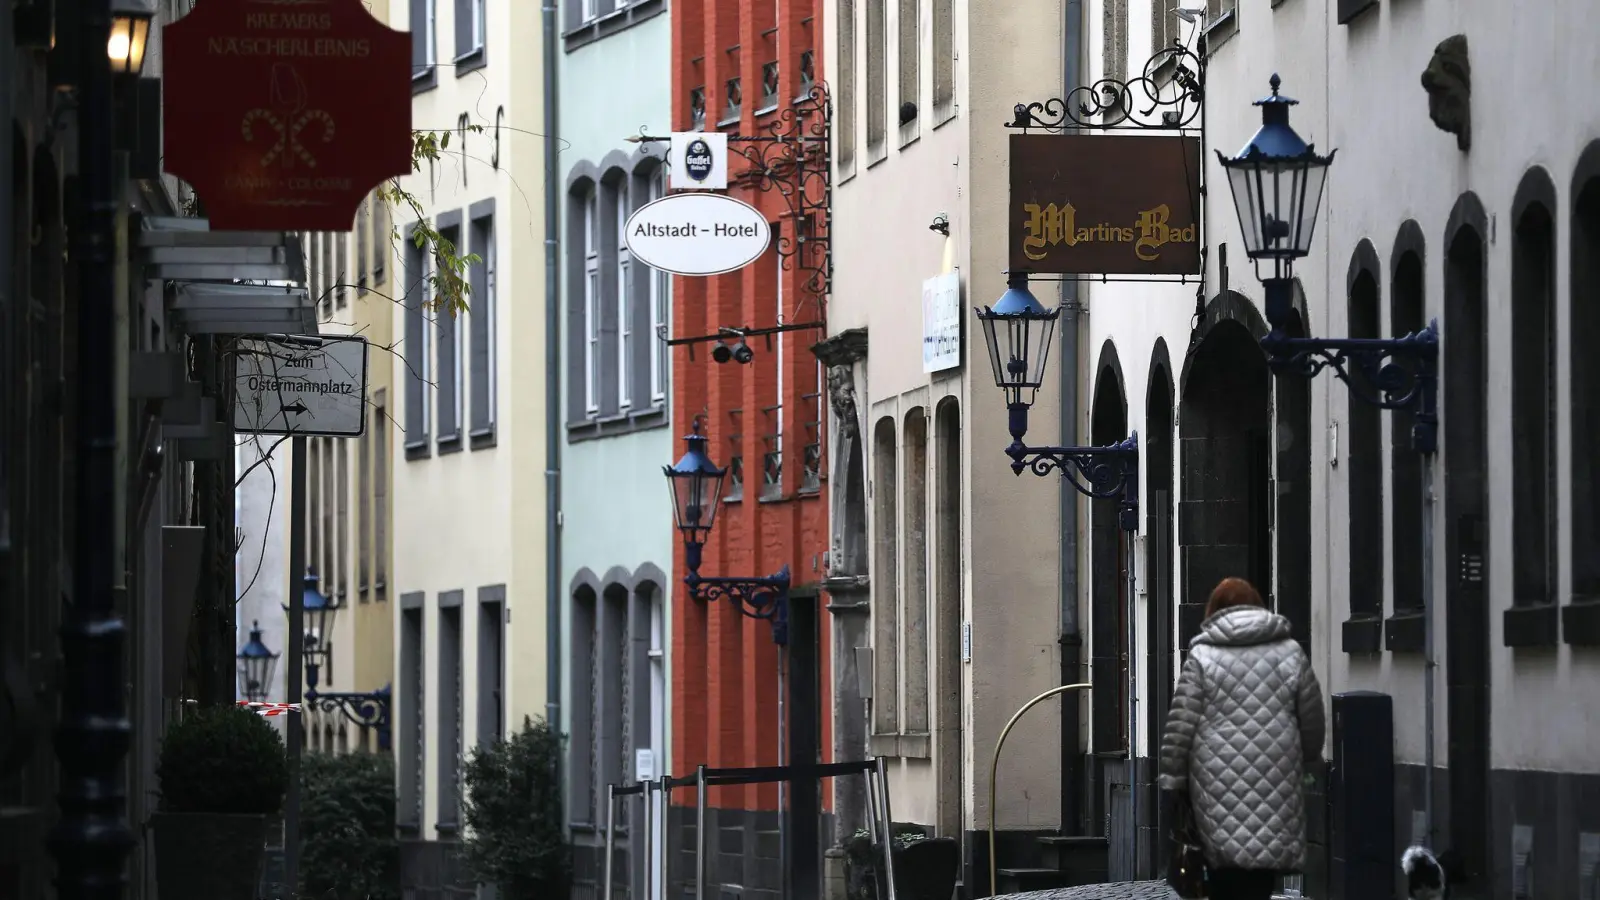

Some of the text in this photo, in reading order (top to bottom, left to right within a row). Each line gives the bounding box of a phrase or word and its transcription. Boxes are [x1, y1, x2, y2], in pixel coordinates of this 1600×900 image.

[246, 12, 331, 30] KREMERS
[687, 155, 711, 165] Gaffel
[634, 222, 696, 237] Altstadt
[714, 222, 758, 237] Hotel
[1023, 202, 1196, 261] Martins Bad
[284, 354, 313, 368] Zum
[248, 377, 352, 395] Ostermannplatz
